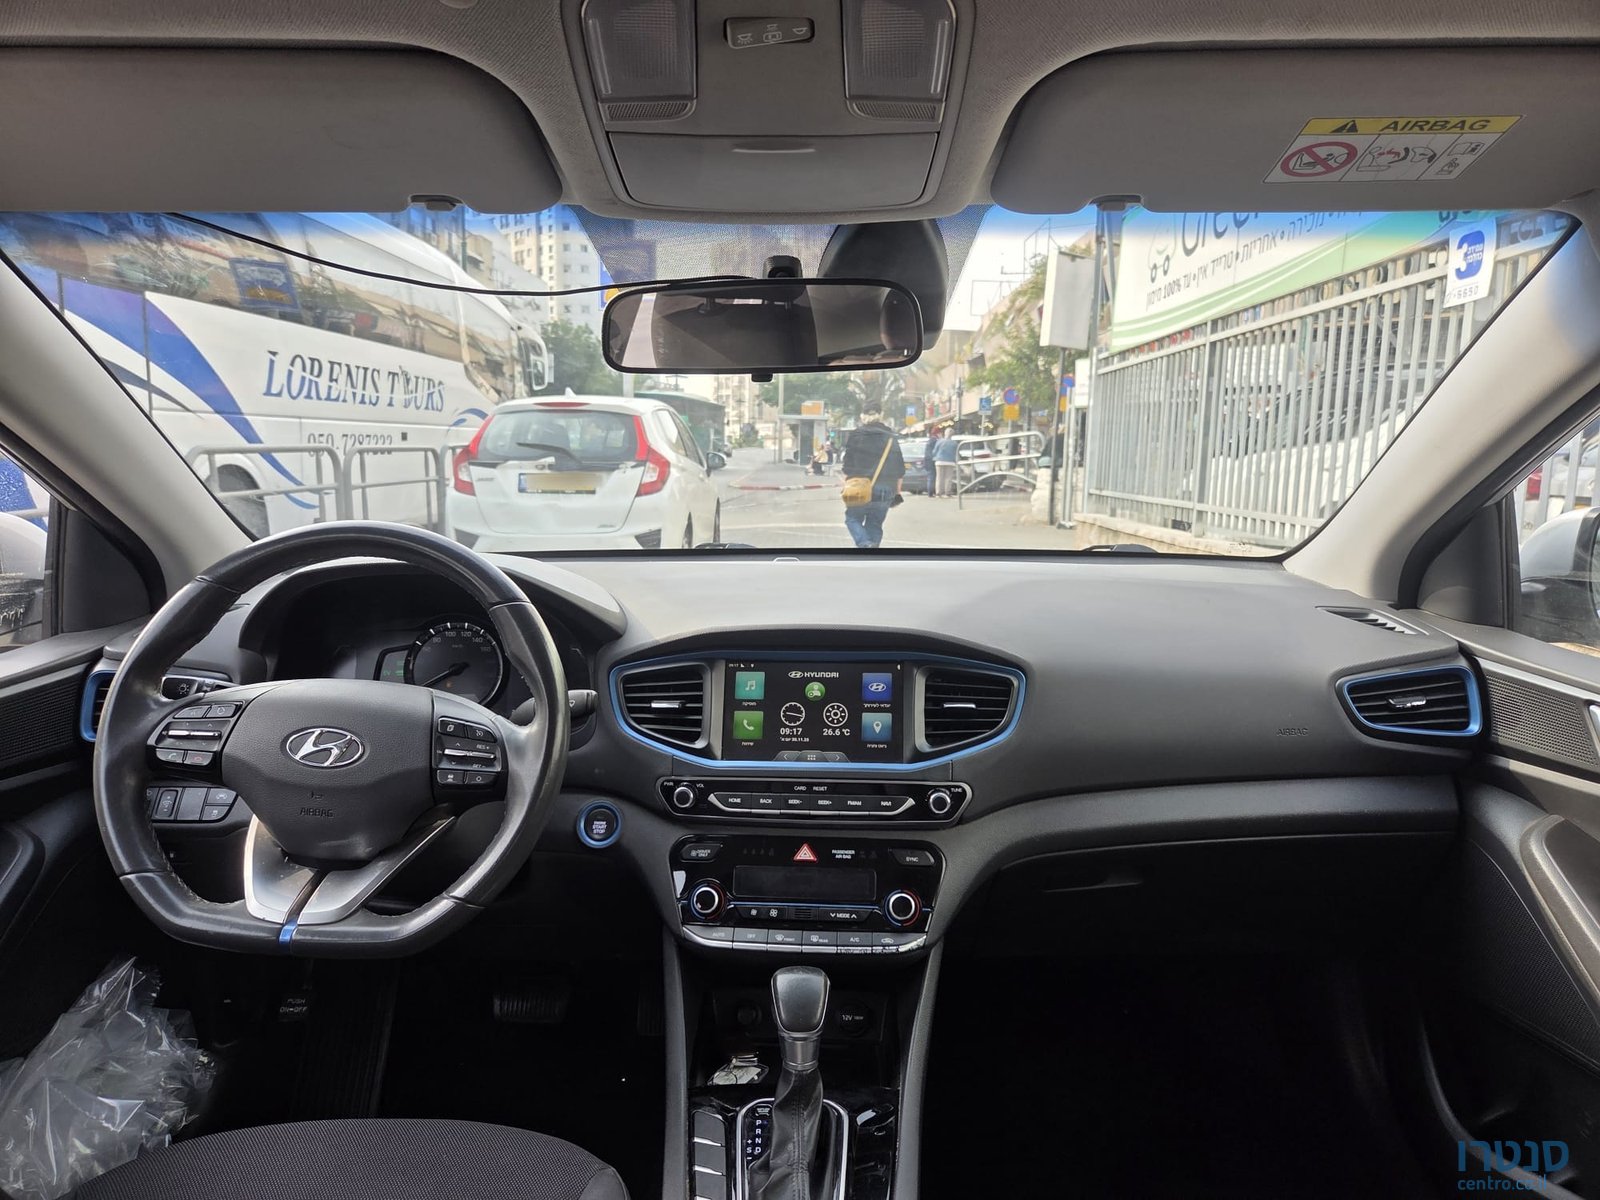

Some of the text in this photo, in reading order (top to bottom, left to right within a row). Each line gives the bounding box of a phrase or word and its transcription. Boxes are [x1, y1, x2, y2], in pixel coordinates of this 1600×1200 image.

[1379, 119, 1491, 132] AIRBAG
[1163, 278, 1182, 299] 100%
[263, 350, 381, 407] LORENIS
[780, 727, 803, 736] 09:17
[823, 728, 840, 736] 26.6
[300, 807, 334, 817] AIRBAG
